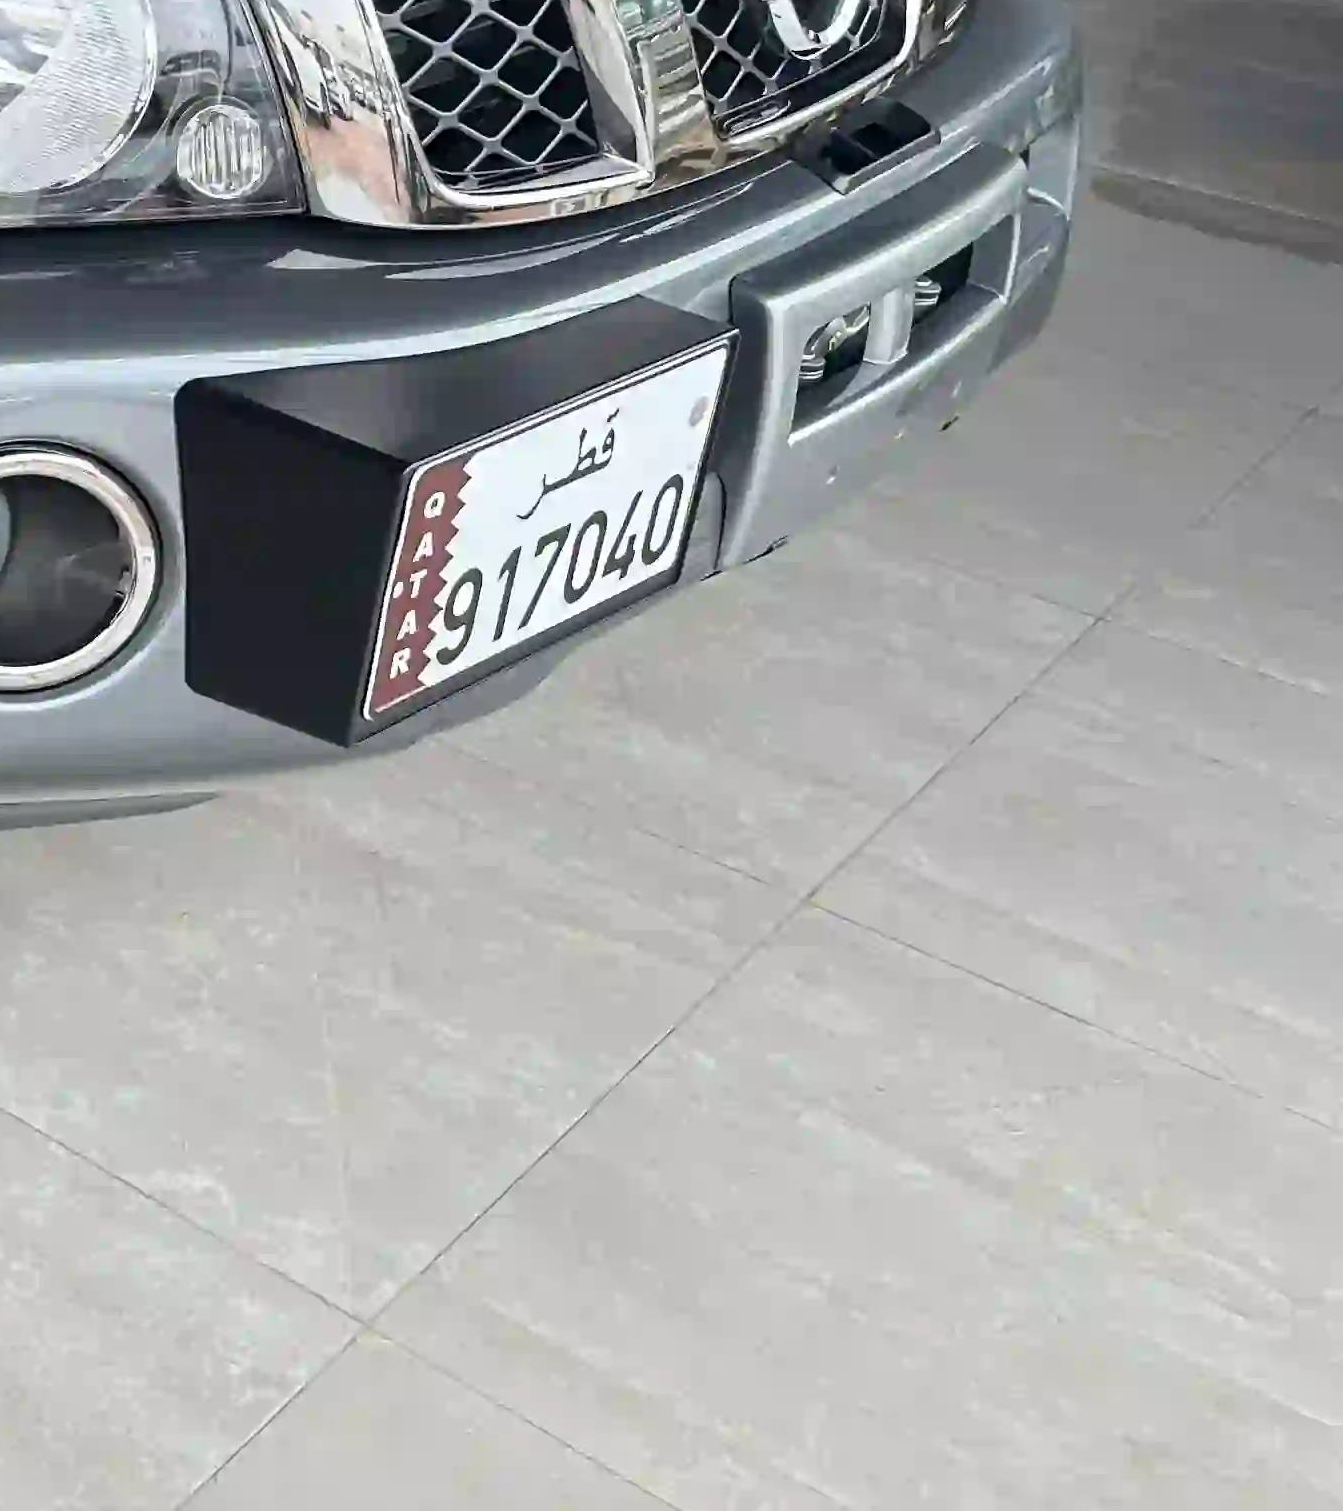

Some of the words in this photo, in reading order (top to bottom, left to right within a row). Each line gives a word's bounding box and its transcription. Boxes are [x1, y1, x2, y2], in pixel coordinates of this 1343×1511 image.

[516, 408, 621, 520] قطر
[389, 490, 446, 680] QATAR
[435, 473, 685, 666] 917040
